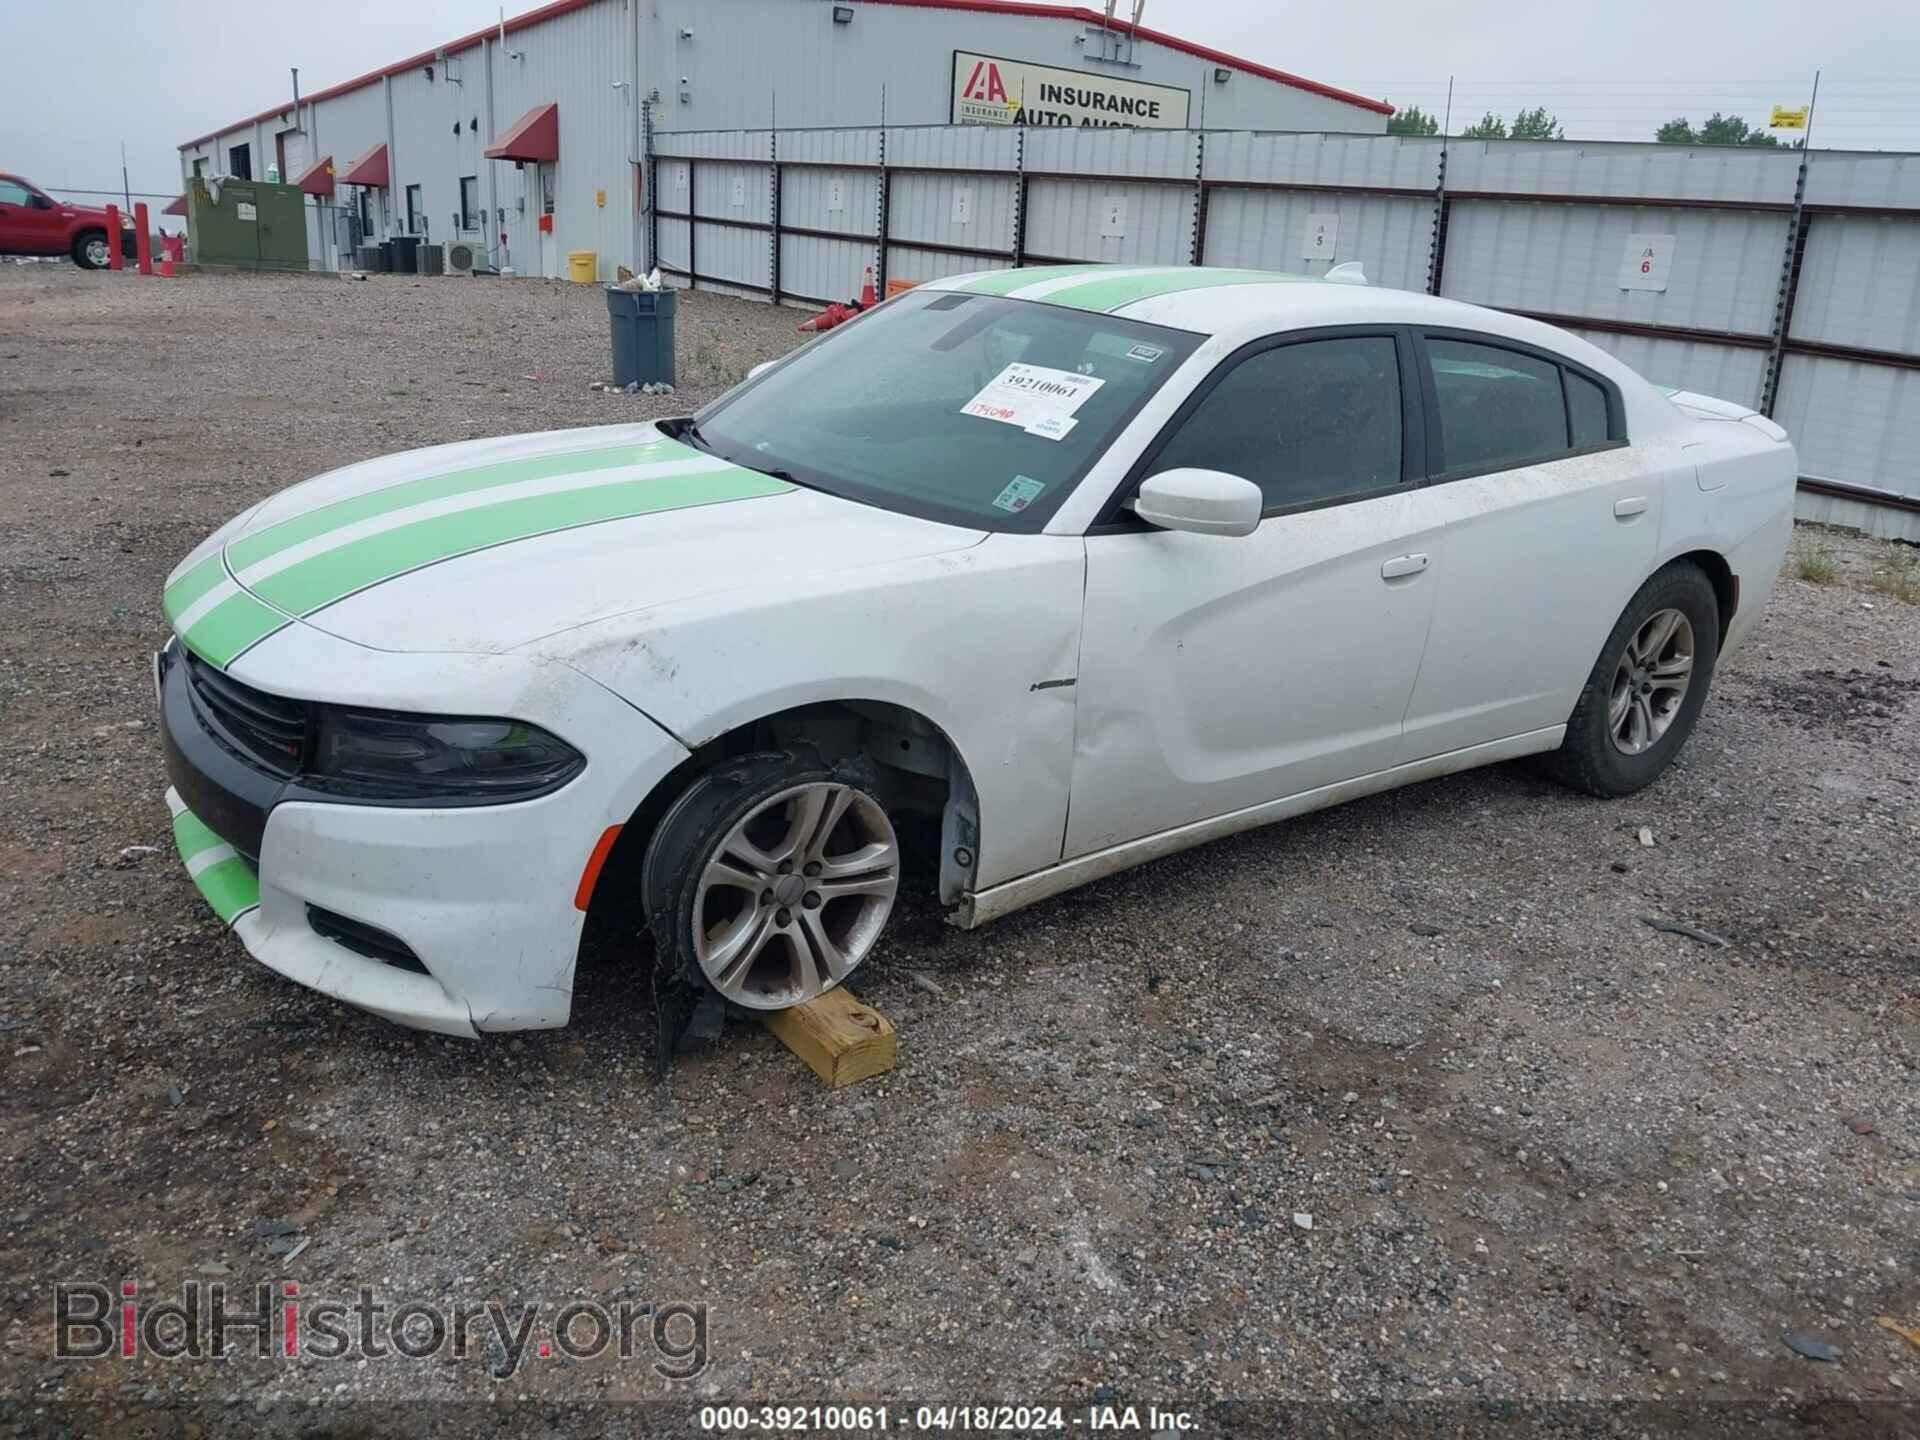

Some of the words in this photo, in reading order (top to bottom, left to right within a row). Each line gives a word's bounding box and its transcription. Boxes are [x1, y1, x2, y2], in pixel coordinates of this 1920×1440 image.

[1040, 83, 1160, 119] INSURANCE
[961, 104, 1008, 119] INSURANCE
[1641, 261, 1650, 273] 6
[1003, 374, 1079, 398] 39210061
